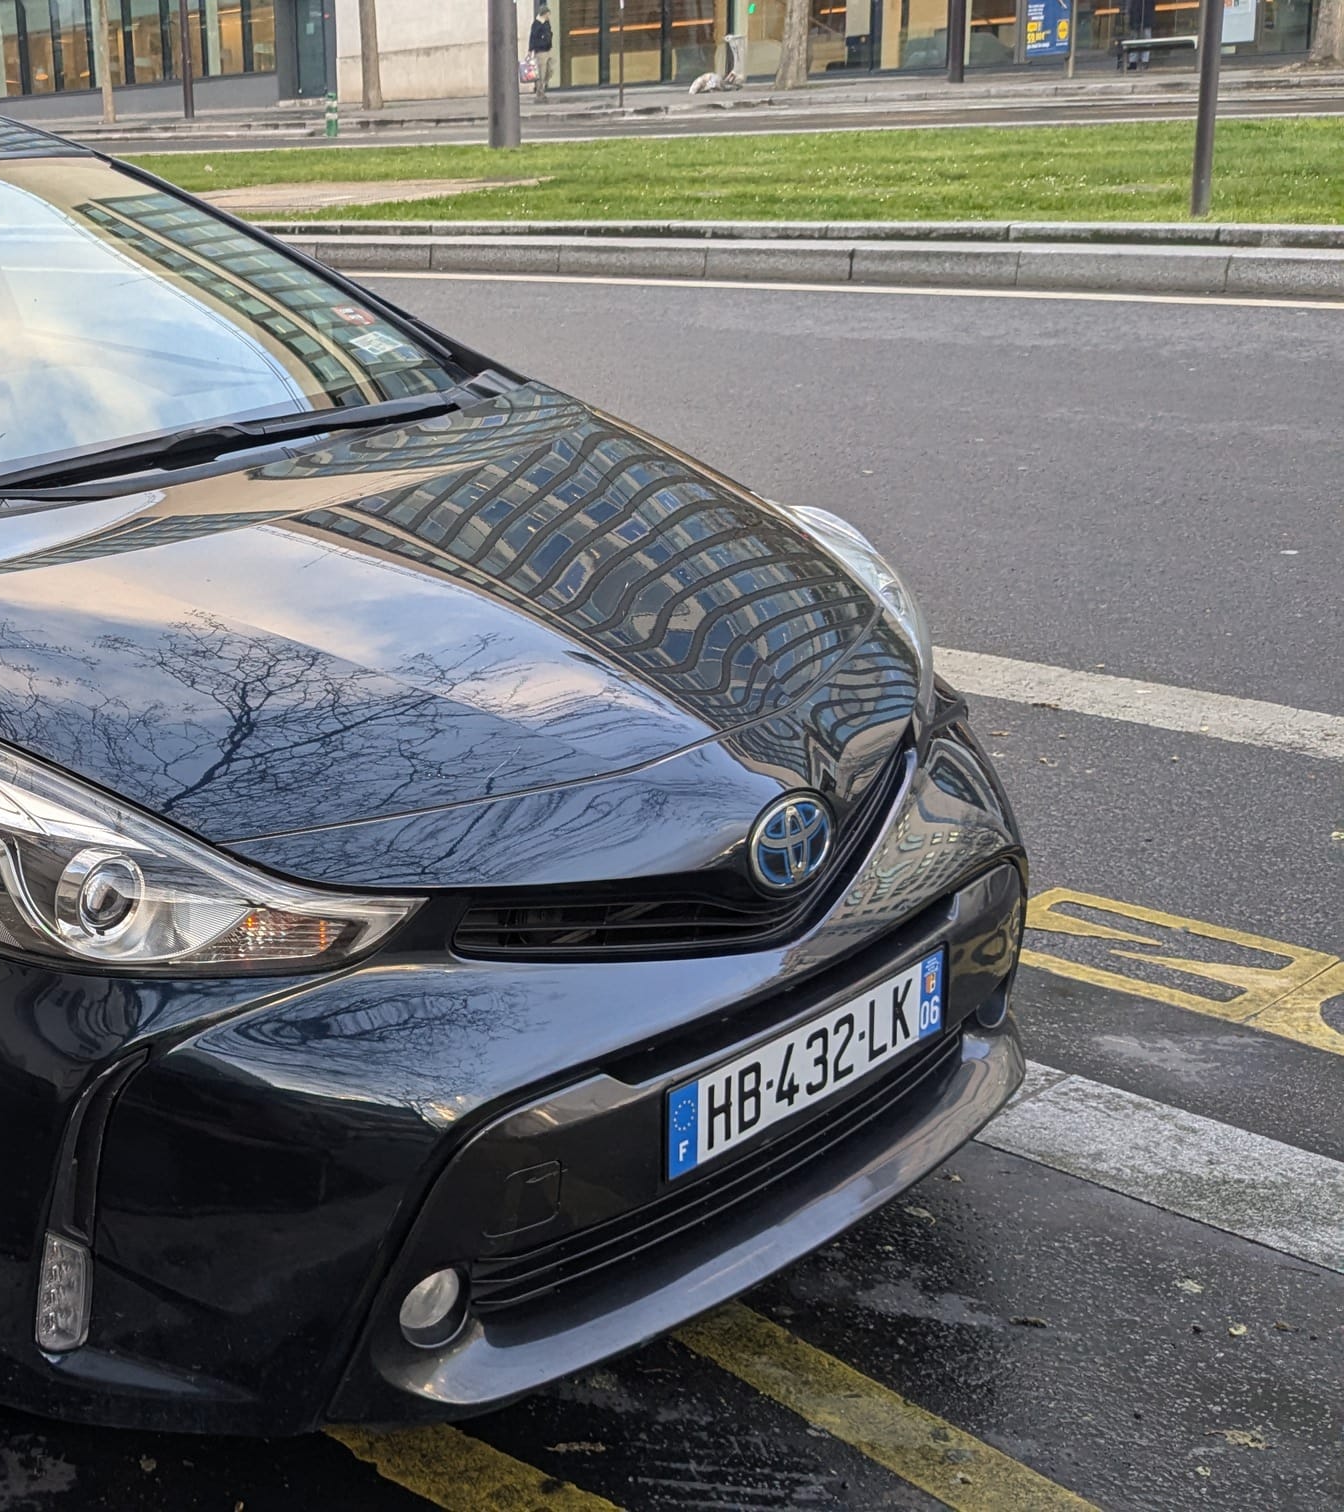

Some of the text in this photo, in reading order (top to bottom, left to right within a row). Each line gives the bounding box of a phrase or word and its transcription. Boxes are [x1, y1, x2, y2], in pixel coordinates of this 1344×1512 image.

[920, 995, 940, 1030] 06
[707, 978, 913, 1151] HB-432-LK
[678, 1140, 689, 1161] F
